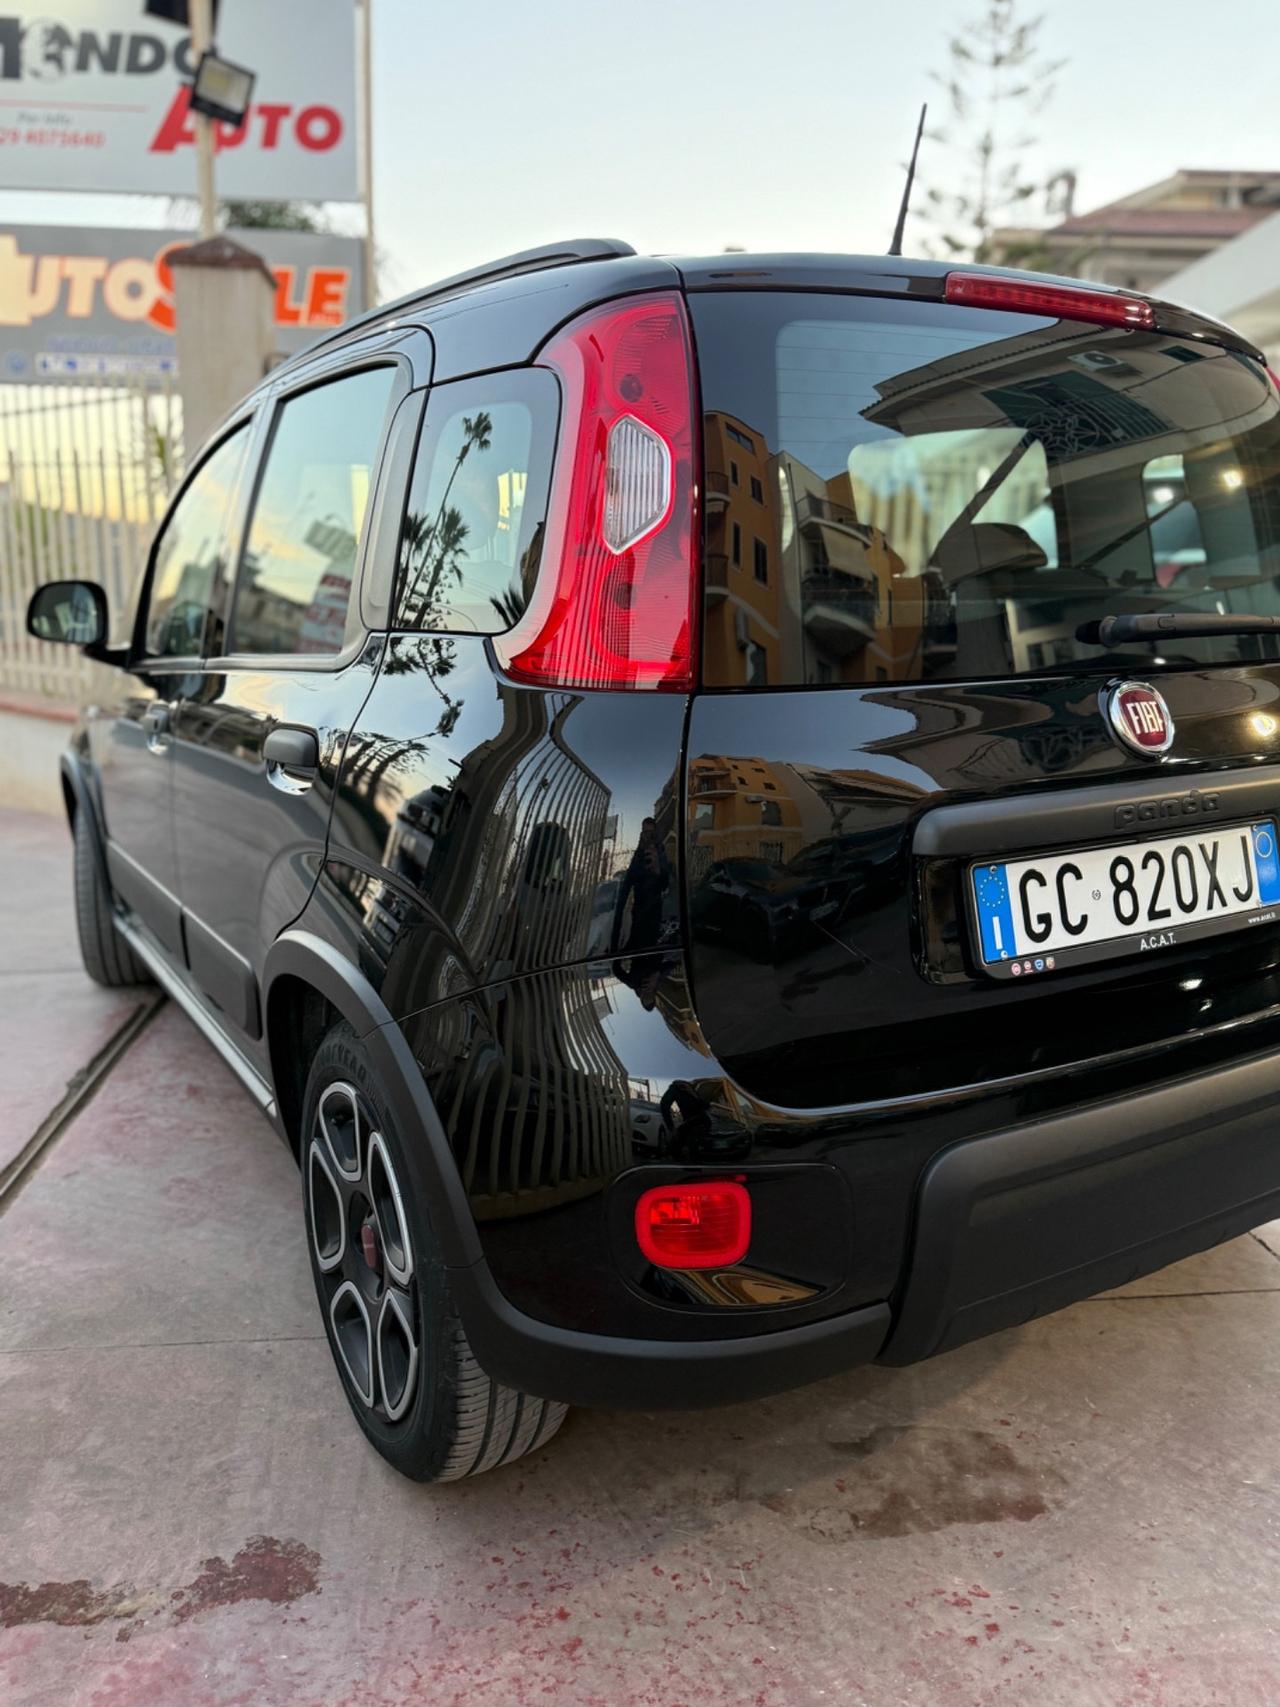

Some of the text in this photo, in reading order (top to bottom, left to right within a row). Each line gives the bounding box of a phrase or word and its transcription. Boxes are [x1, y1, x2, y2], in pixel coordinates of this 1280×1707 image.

[1126, 701, 1164, 735] FIAT
[1114, 789, 1221, 829] panda
[1019, 863, 1088, 943] GC
[1109, 836, 1253, 925] 820XJ
[1139, 932, 1177, 951] A.C.A.T.
